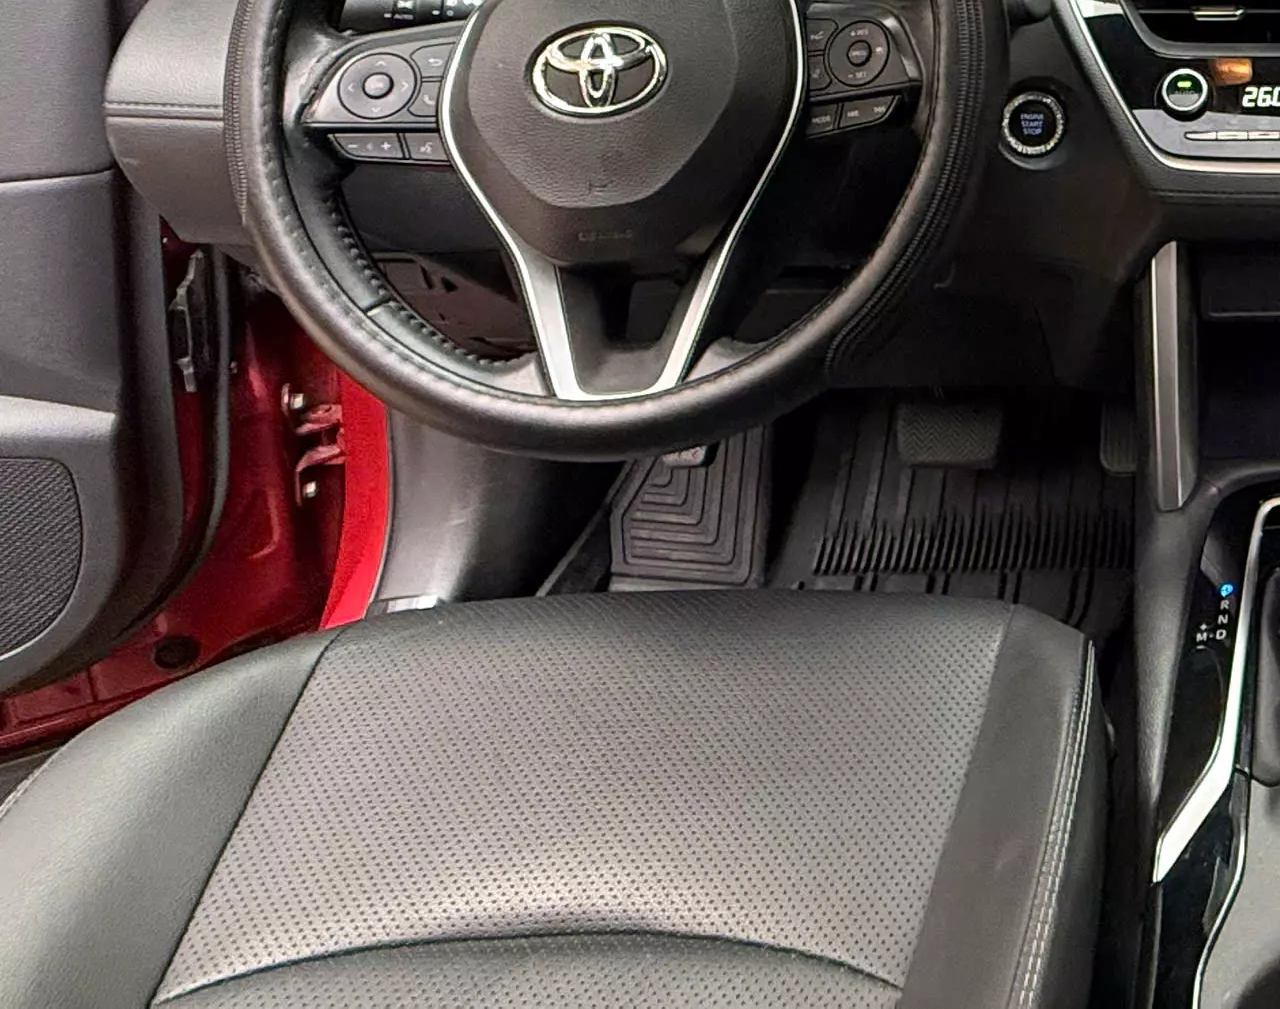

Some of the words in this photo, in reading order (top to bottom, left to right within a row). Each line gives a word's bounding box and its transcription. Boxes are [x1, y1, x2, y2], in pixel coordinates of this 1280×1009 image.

[1220, 600, 1229, 610] R
[1217, 614, 1228, 624] N
[1196, 632, 1207, 642] M
[1215, 629, 1227, 640] D
